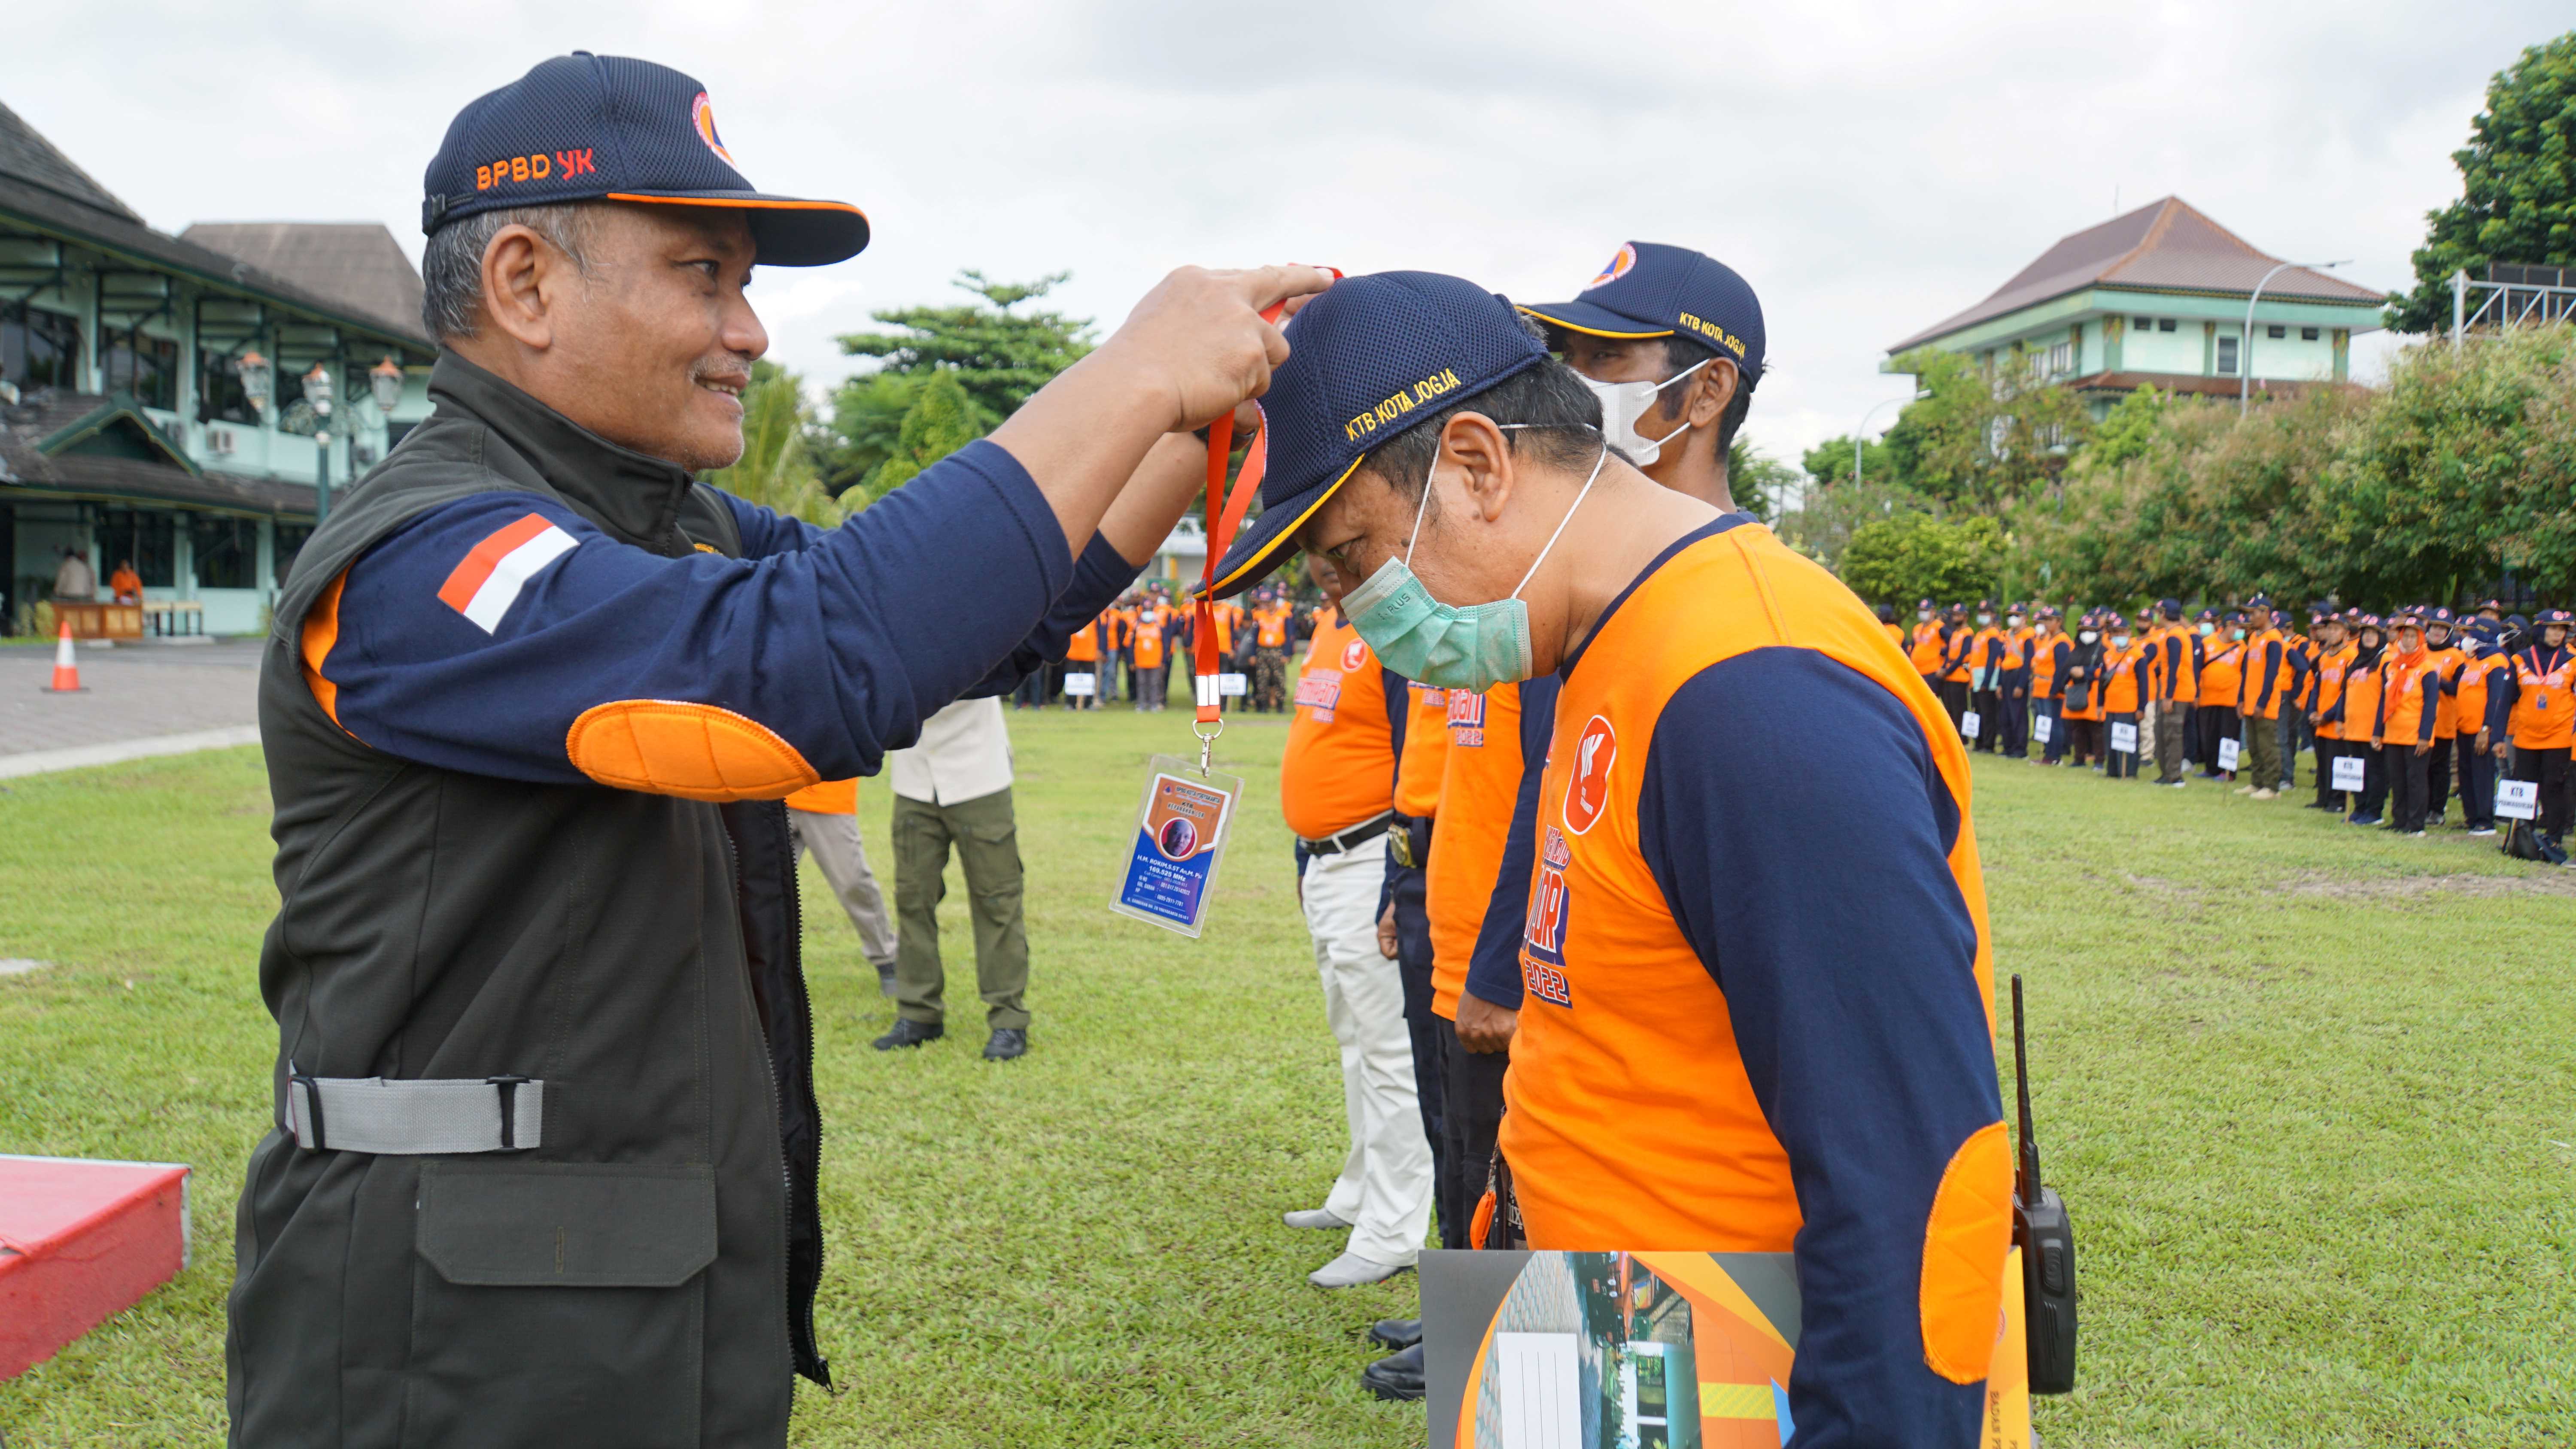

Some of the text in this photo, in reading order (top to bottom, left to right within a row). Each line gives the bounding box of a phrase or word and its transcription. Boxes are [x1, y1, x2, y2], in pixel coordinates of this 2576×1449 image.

[476, 148, 596, 190] BPBD YK
[1679, 312, 1746, 361] KTB KOTA JOGJA
[1345, 368, 1461, 441] KTB KOTA JOGJA
[1456, 729, 1484, 746] 2022
[1525, 958, 1569, 1005] 2022
